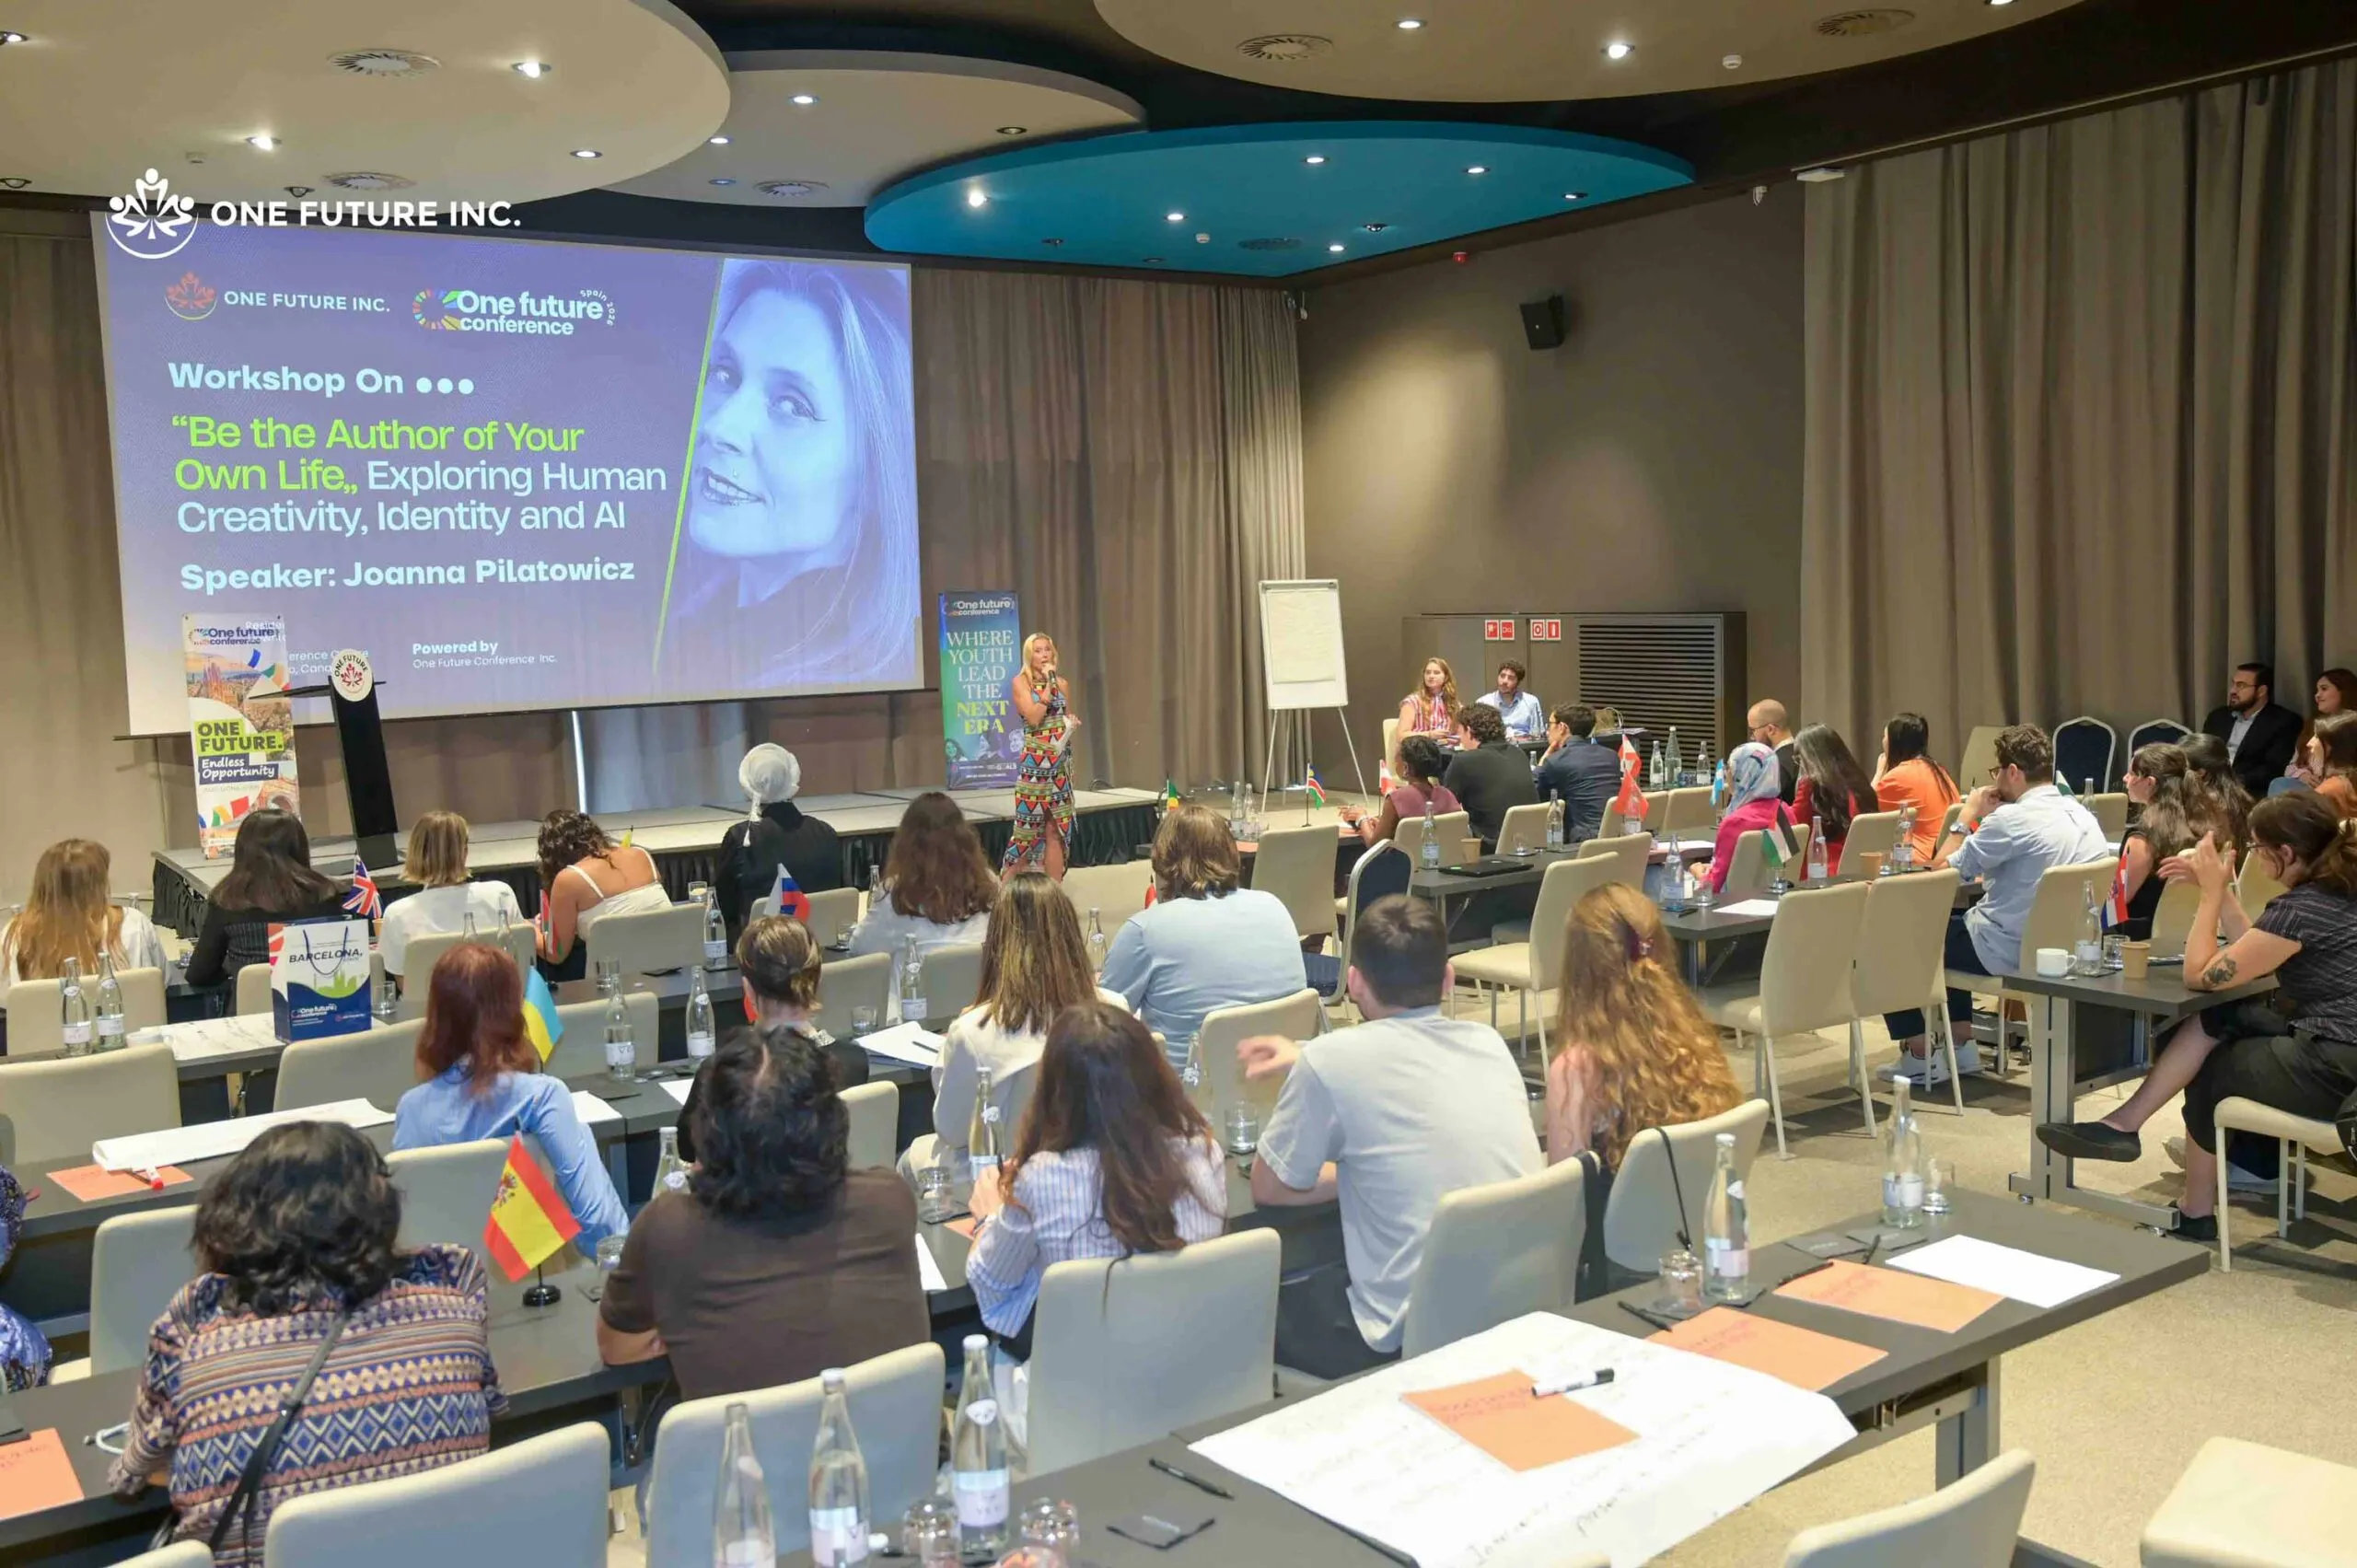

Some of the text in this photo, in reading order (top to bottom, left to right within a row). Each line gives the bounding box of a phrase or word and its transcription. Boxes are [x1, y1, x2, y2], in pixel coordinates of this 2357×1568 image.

[224, 290, 390, 313] ONE FUTURE INC.
[457, 290, 604, 319] One future
[459, 315, 575, 335] conference
[168, 363, 403, 398] Workshop On
[250, 417, 316, 449] the
[326, 418, 454, 450] Author
[463, 420, 500, 450] of
[505, 422, 586, 453] Your
[175, 459, 267, 492] Own
[367, 459, 532, 497] Exploring
[543, 461, 668, 493] Human
[177, 500, 625, 538] Creativity, Identity and AI
[180, 556, 635, 596] Speaker: Joanna Pilatowicz
[958, 598, 1011, 610] One future
[208, 628, 235, 638] One
[237, 626, 275, 637] future
[946, 630, 1014, 646] WHERE
[412, 640, 499, 656] Powered by
[948, 647, 1013, 665] YOUTH
[343, 655, 368, 672] FUTURE
[412, 654, 557, 668] One Future Conference Inc.
[958, 666, 1006, 682] LEAD
[962, 683, 1003, 699] THE
[957, 700, 1010, 717] NEXT
[198, 721, 240, 737] ONE
[964, 718, 1005, 736] ERA
[200, 735, 283, 752] FUTURE.
[202, 757, 245, 769] Endless
[202, 765, 275, 781] Opportunity
